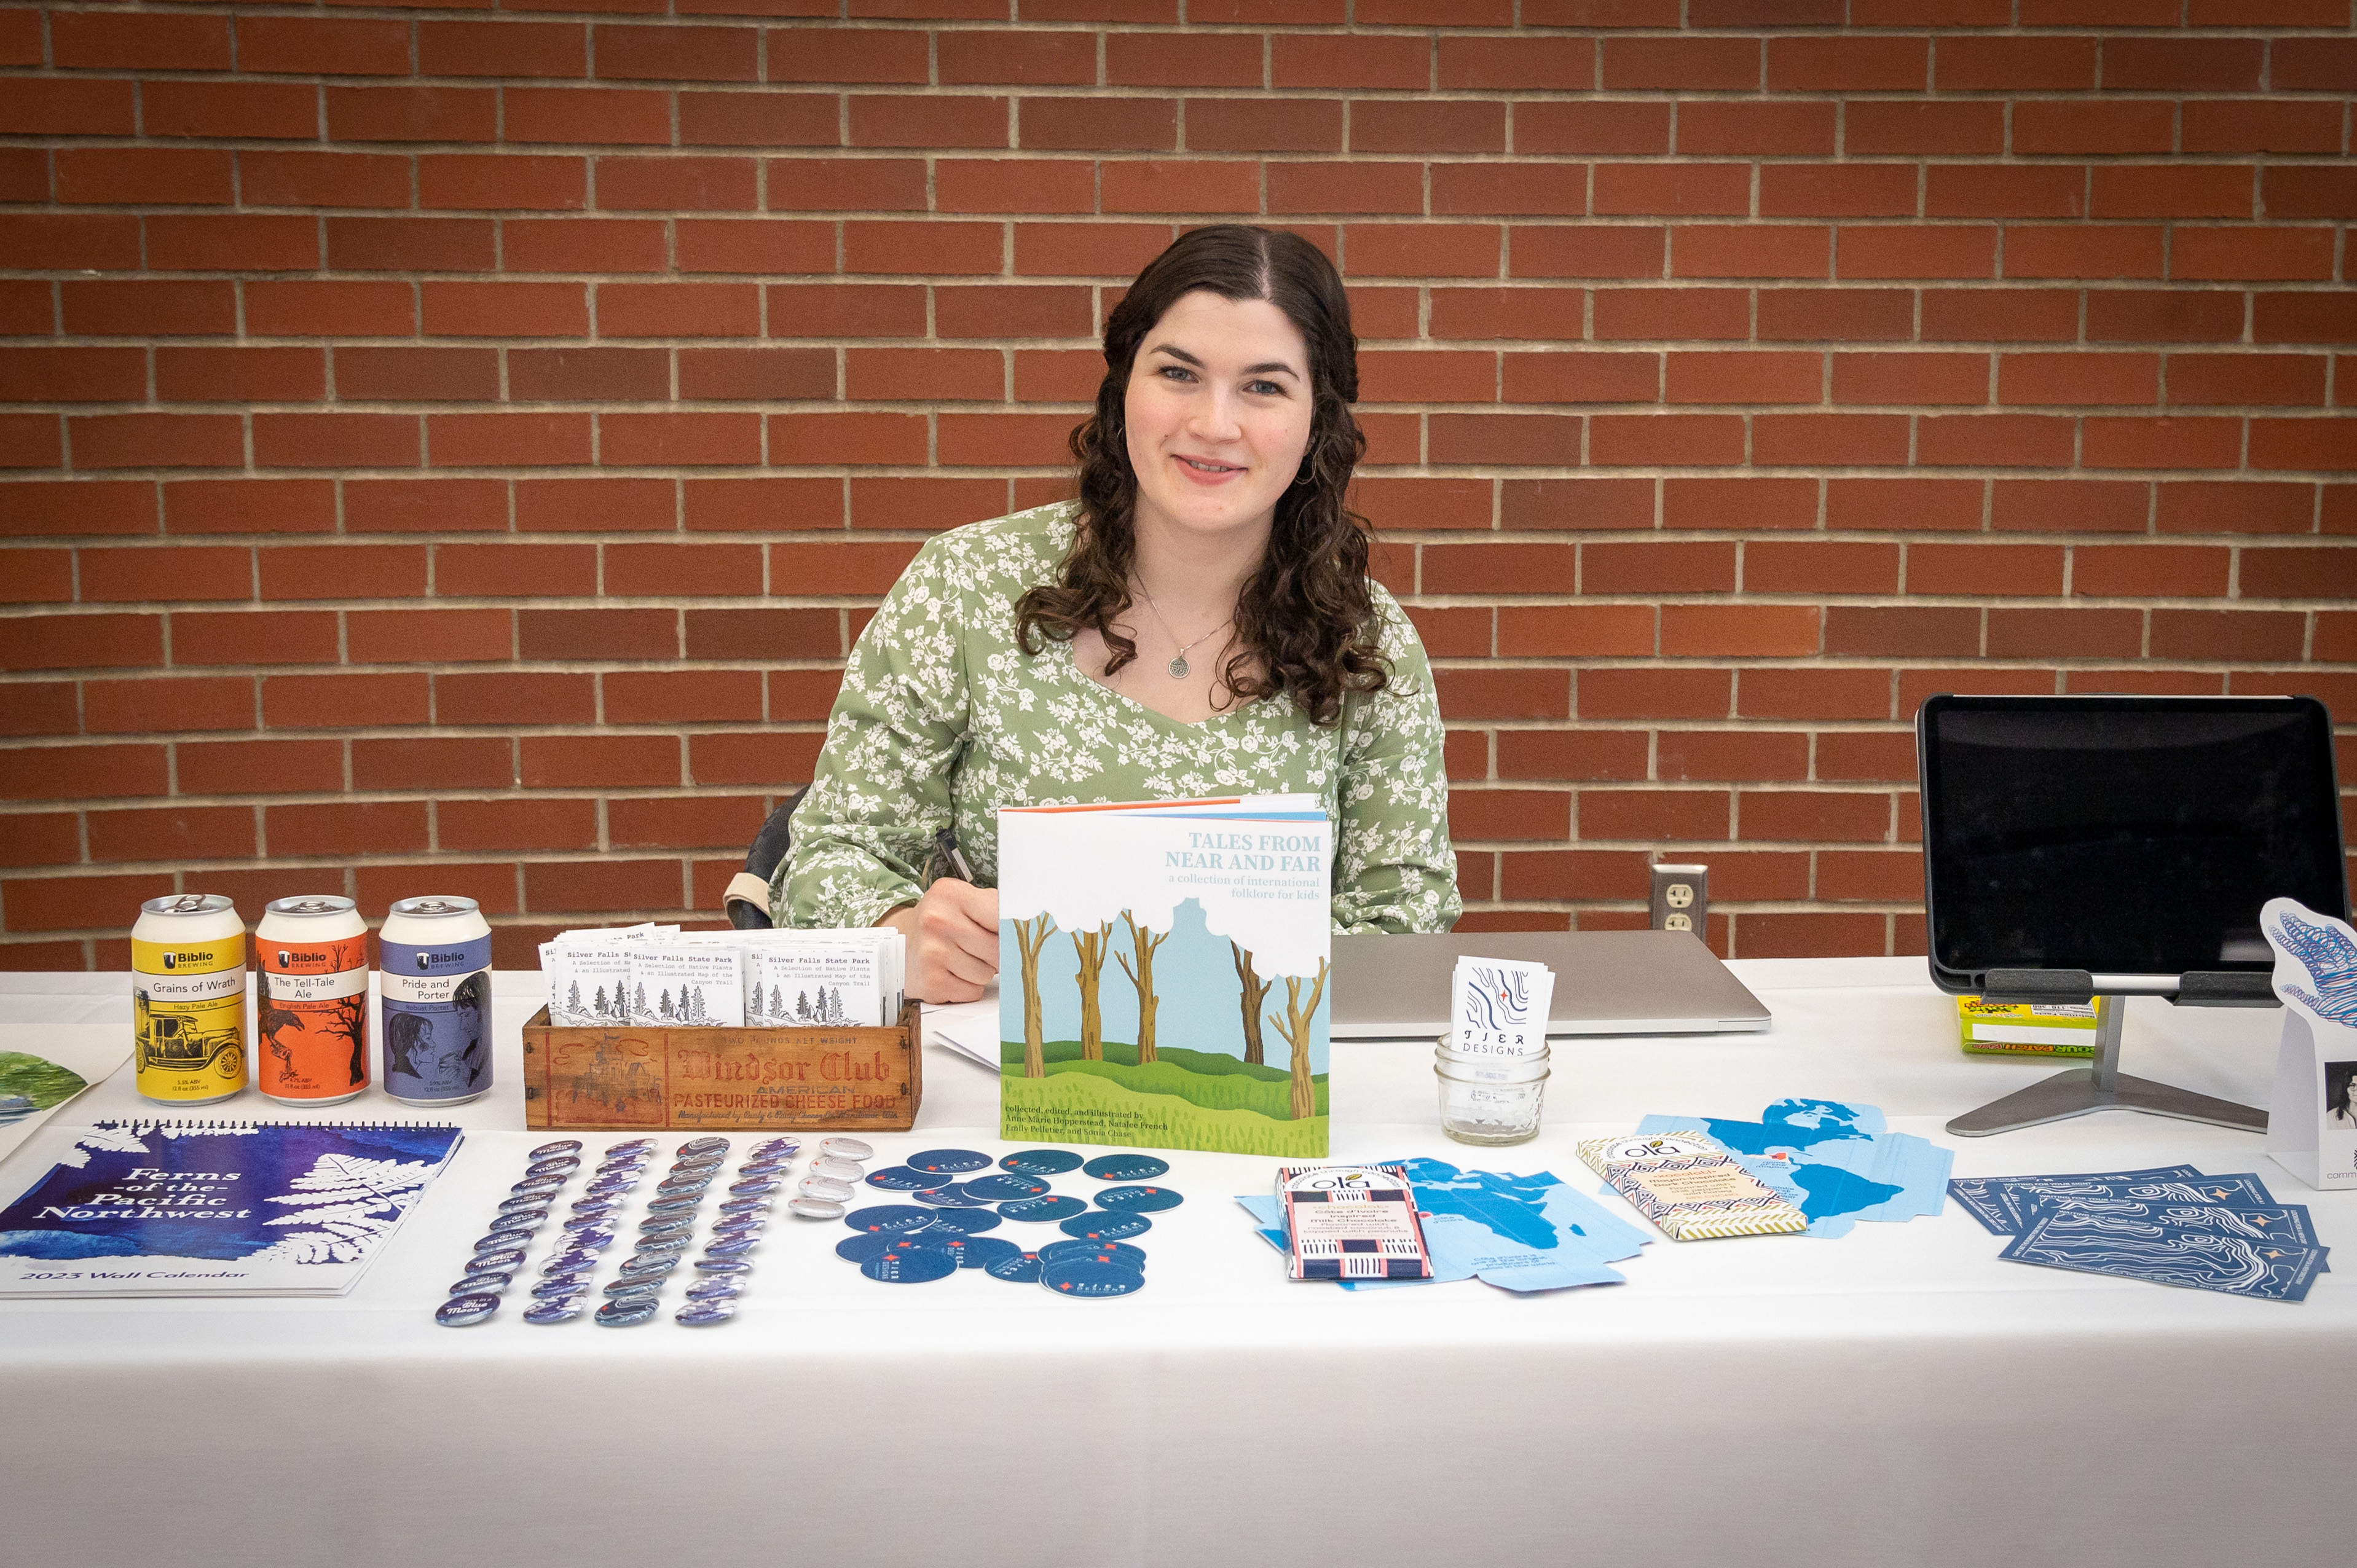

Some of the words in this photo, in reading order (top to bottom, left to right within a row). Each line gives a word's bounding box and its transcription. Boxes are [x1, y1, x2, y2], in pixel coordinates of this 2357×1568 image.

[1189, 833, 1253, 850] TALES
[1258, 835, 1321, 852] FROM
[1165, 851, 1223, 869] NEAR
[1229, 854, 1275, 871] AND
[1280, 856, 1321, 872] FAR
[1178, 874, 1230, 885] collection
[1234, 876, 1245, 885] of
[1248, 876, 1320, 887] international
[1231, 888, 1274, 899] folklore
[1278, 890, 1294, 900] for
[1297, 890, 1320, 900] kids
[178, 952, 213, 962] Biblio
[291, 952, 326, 962] Biblio
[431, 953, 465, 963] Biblio
[153, 982, 187, 993] Grains
[192, 982, 203, 992] of
[207, 976, 235, 990] Wrath
[274, 977, 291, 987] The
[294, 977, 334, 987] Tell-Tale
[403, 979, 427, 989] Pride
[430, 979, 449, 988] and
[295, 989, 312, 998] Ale
[418, 990, 450, 1000] Porter
[1465, 1030, 1524, 1045] TIER
[1463, 1043, 1523, 1056] DESIGNS
[677, 1049, 811, 1084] Windsor
[820, 1051, 890, 1081] Club
[756, 1086, 856, 1095] AMERICAN
[675, 1093, 779, 1108] PASTEURIZED
[785, 1094, 846, 1109] CHEESE
[852, 1095, 896, 1110] FOOD
[679, 1110, 731, 1123] Manufactured
[733, 1111, 741, 1123] by
[1005, 1105, 1044, 1115] collected,
[1091, 1110, 1132, 1118] illustrated
[1134, 1111, 1144, 1121] by
[1053, 1118, 1106, 1128] Hopperstead,
[1005, 1124, 1028, 1135] Emily
[1031, 1126, 1065, 1135] Pelletier,
[122, 1168, 242, 1181] Ferns
[84, 1194, 227, 1206] Pacific
[33, 1206, 252, 1219] Northwest
[476, 1258, 511, 1268] Moon
